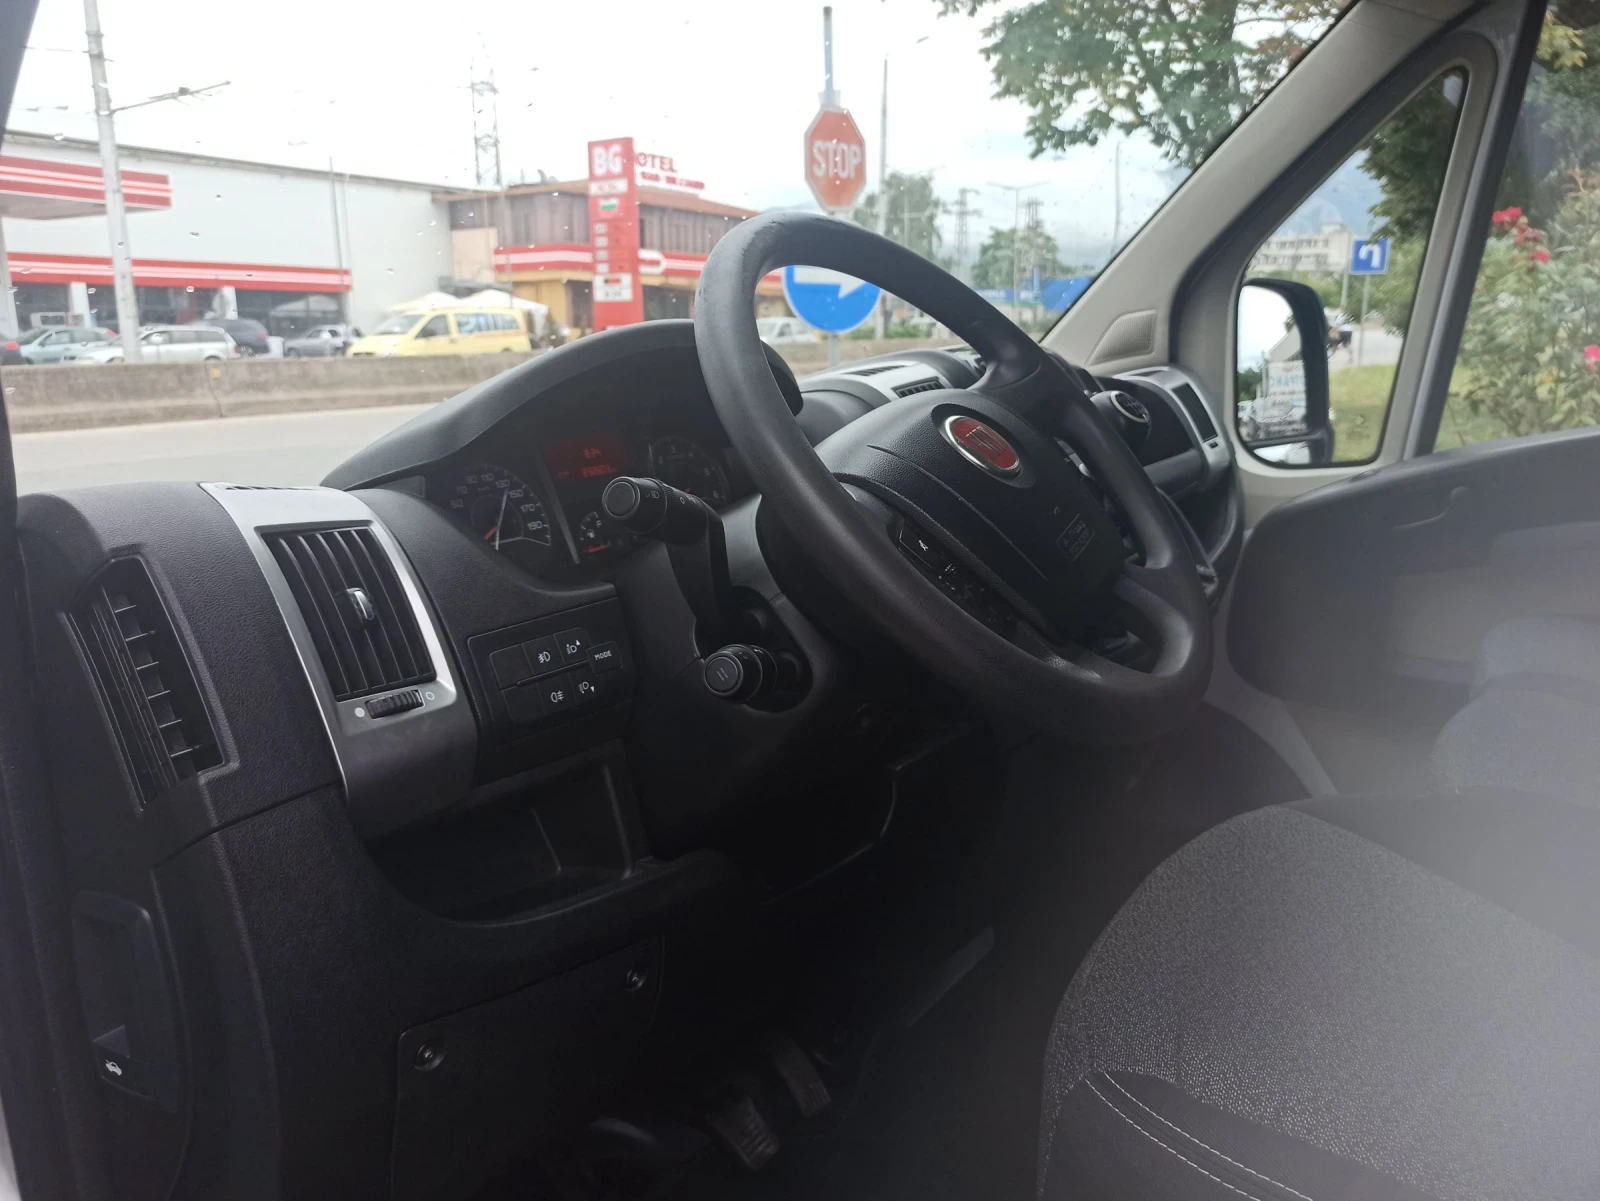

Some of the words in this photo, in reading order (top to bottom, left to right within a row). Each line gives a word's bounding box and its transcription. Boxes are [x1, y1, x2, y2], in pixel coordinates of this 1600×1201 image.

[592, 144, 624, 175] BG
[634, 152, 678, 173] OTEL
[813, 139, 862, 179] STOP
[508, 489, 524, 499] 150
[520, 503, 536, 513] 170
[594, 649, 613, 660] MODE
